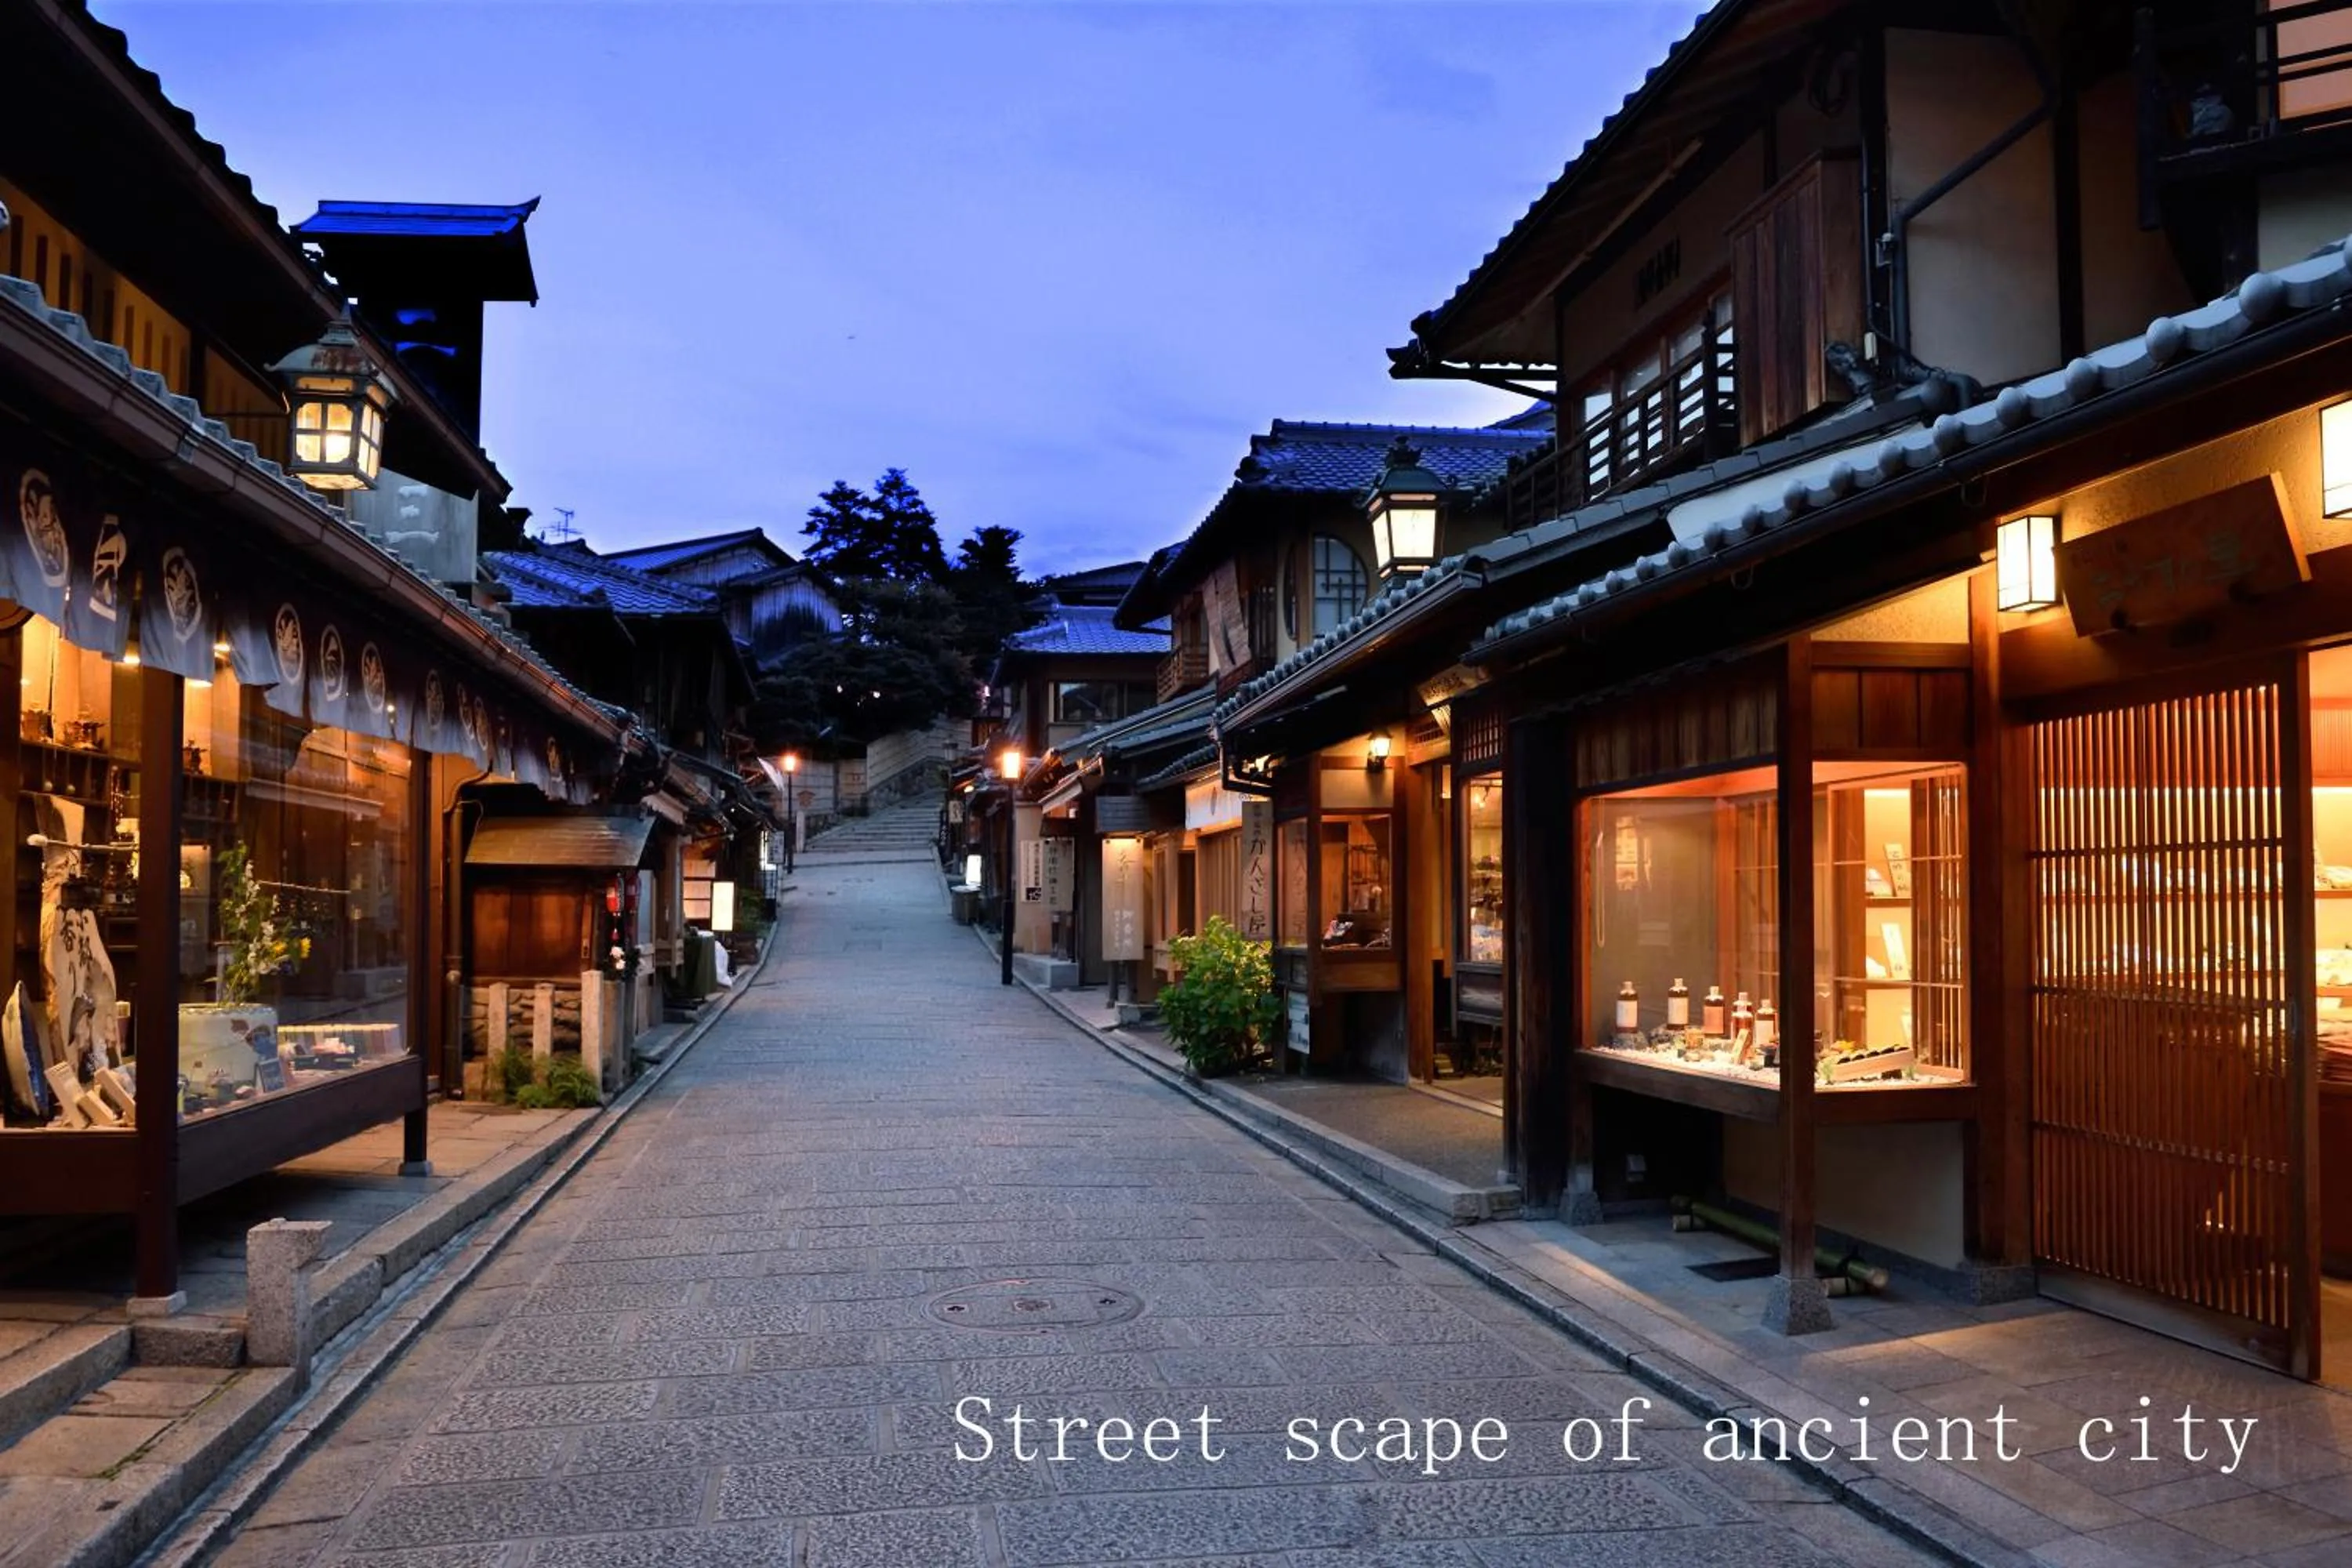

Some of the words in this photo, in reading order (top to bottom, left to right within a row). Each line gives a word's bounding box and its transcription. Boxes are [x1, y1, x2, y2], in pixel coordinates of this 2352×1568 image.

[1250, 839, 1267, 935] かんざし屋
